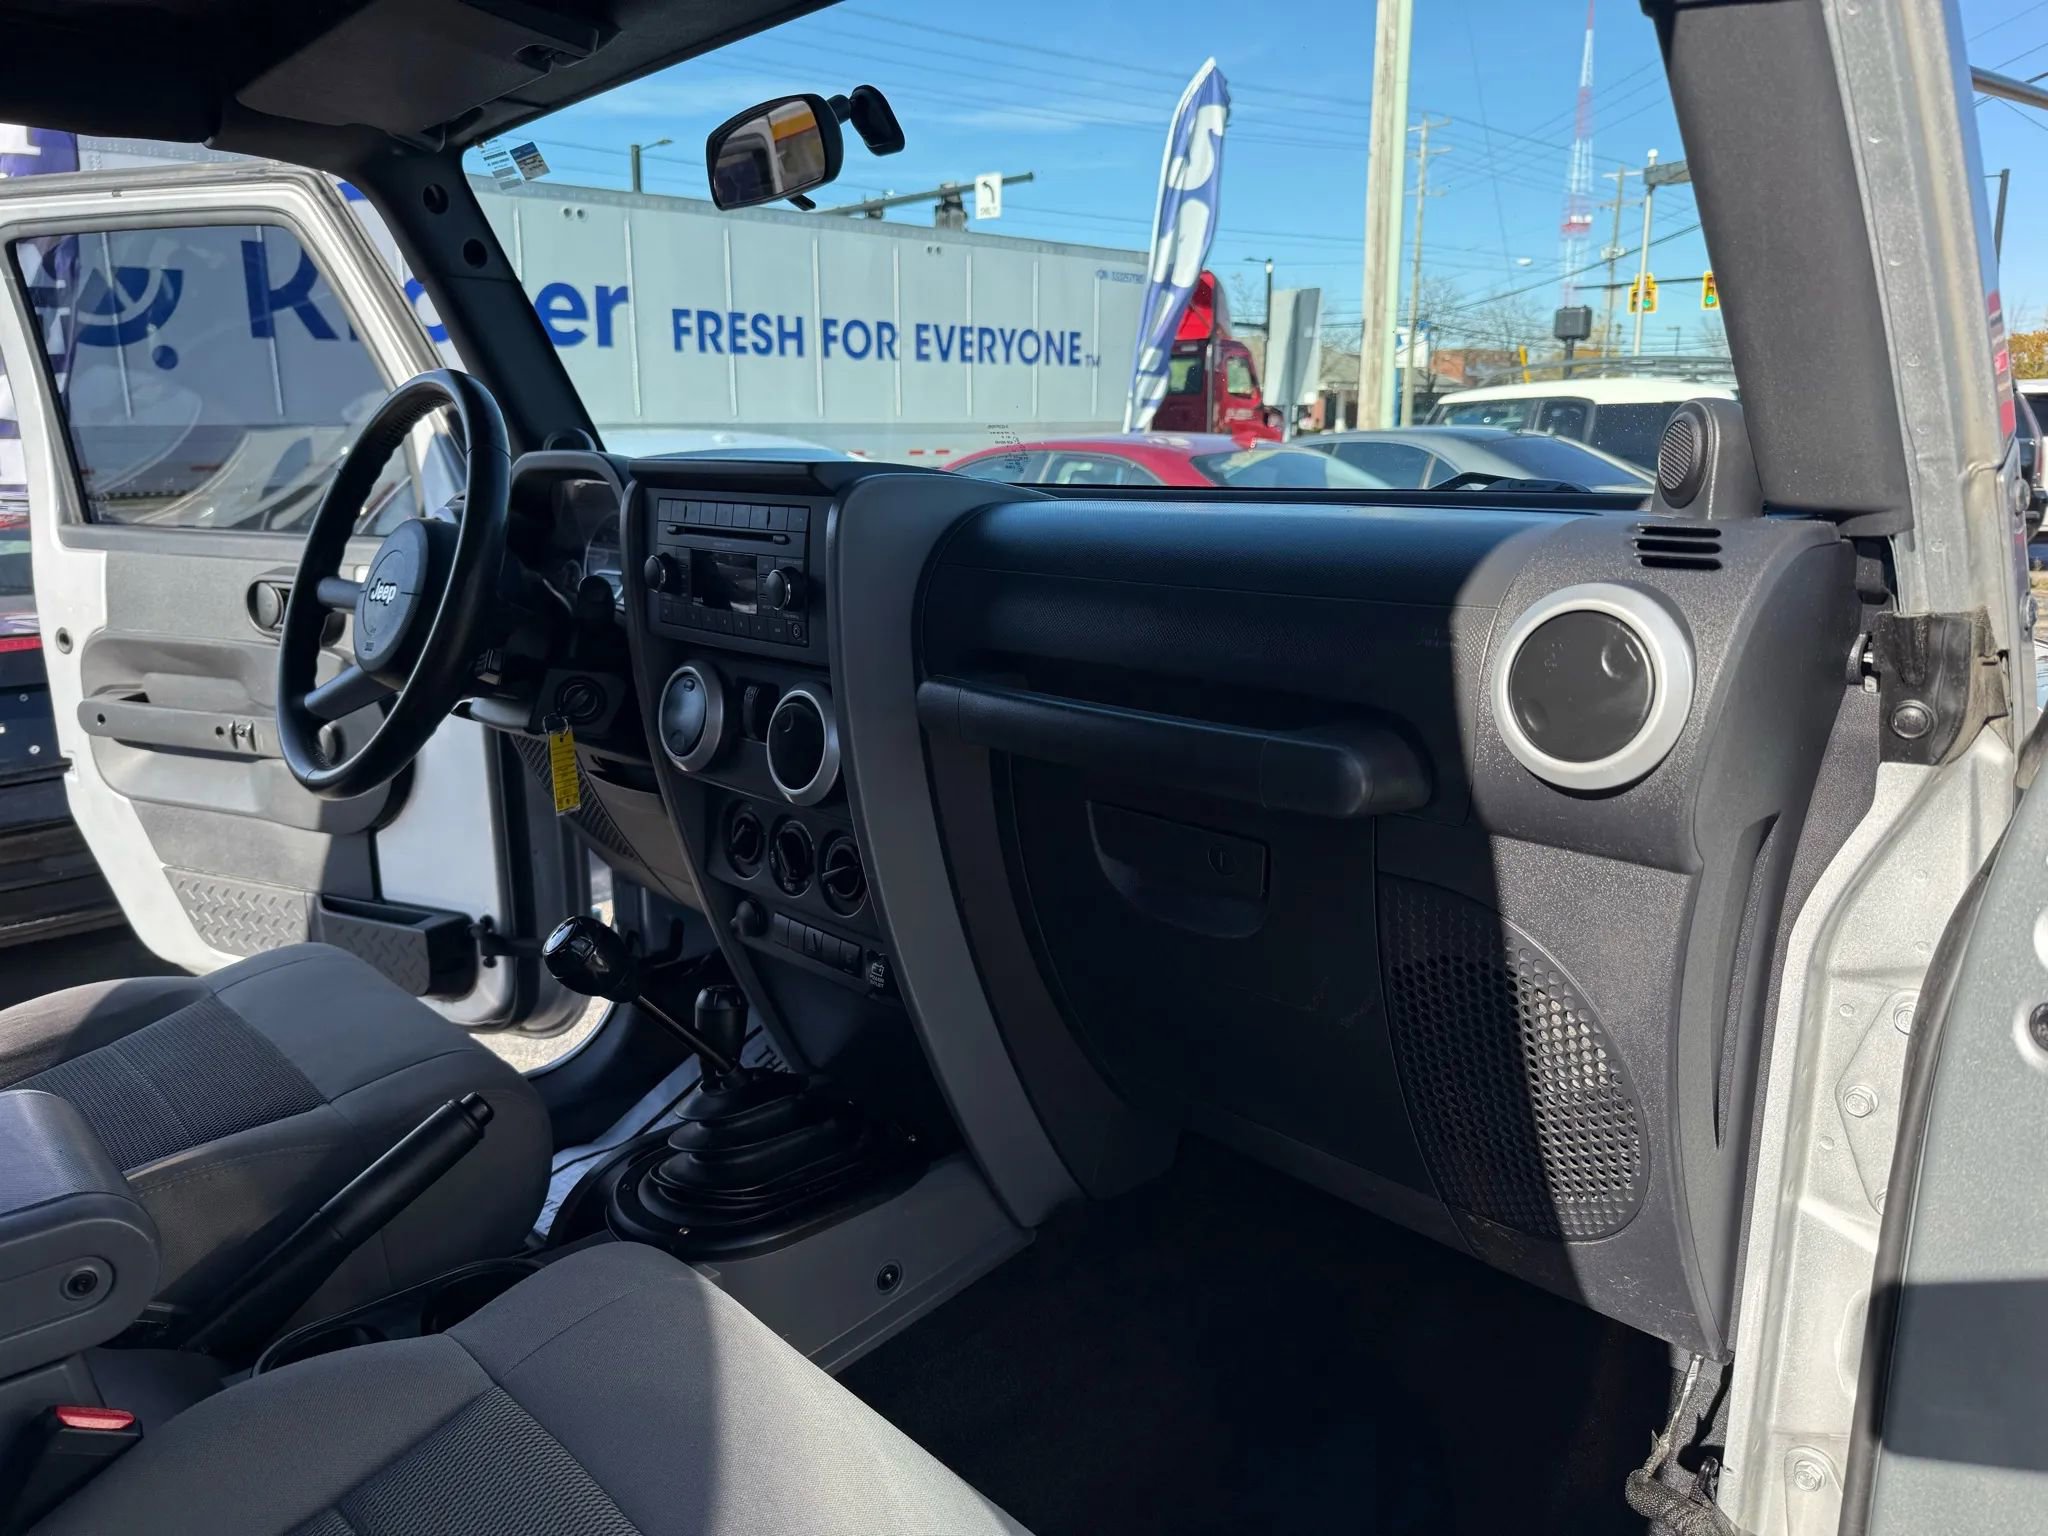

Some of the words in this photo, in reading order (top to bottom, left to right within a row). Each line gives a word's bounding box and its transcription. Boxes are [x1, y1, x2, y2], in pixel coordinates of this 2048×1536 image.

[672, 308, 804, 358] FRESH
[822, 318, 899, 361] FOR
[915, 323, 1082, 367] EVERYONE
[370, 578, 397, 606] Jeep
